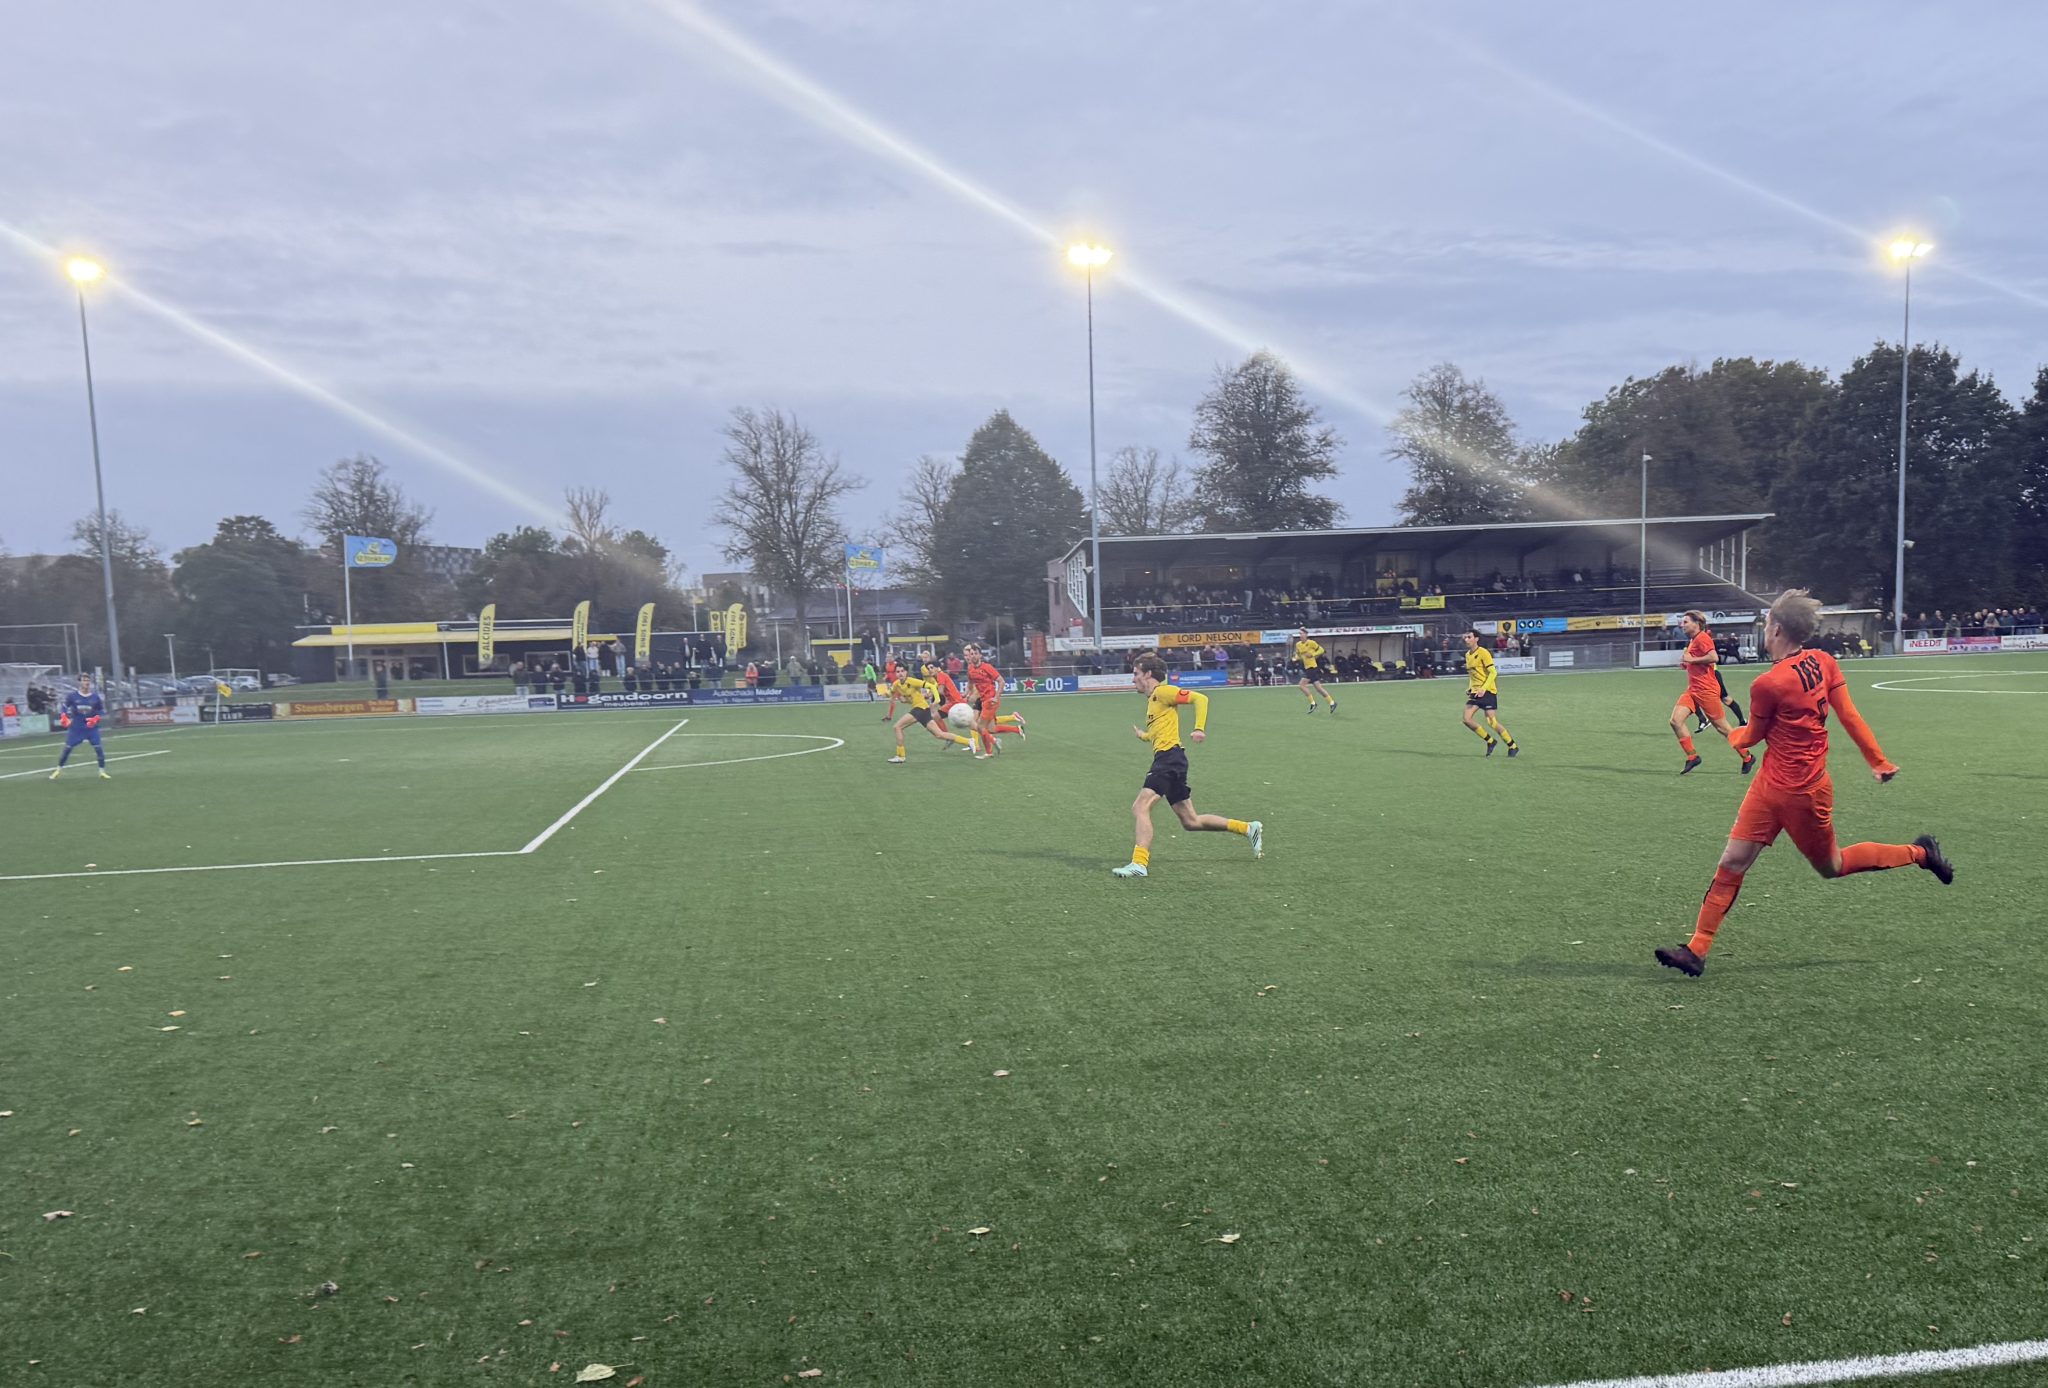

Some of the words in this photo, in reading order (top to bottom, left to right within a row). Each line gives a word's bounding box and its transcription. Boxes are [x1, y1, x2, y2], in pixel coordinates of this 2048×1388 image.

[482, 616, 491, 651] ALCIDES
[1176, 634, 1202, 643] LORD
[1206, 632, 1242, 642] NELSON
[560, 691, 688, 704] Hogendoorn
